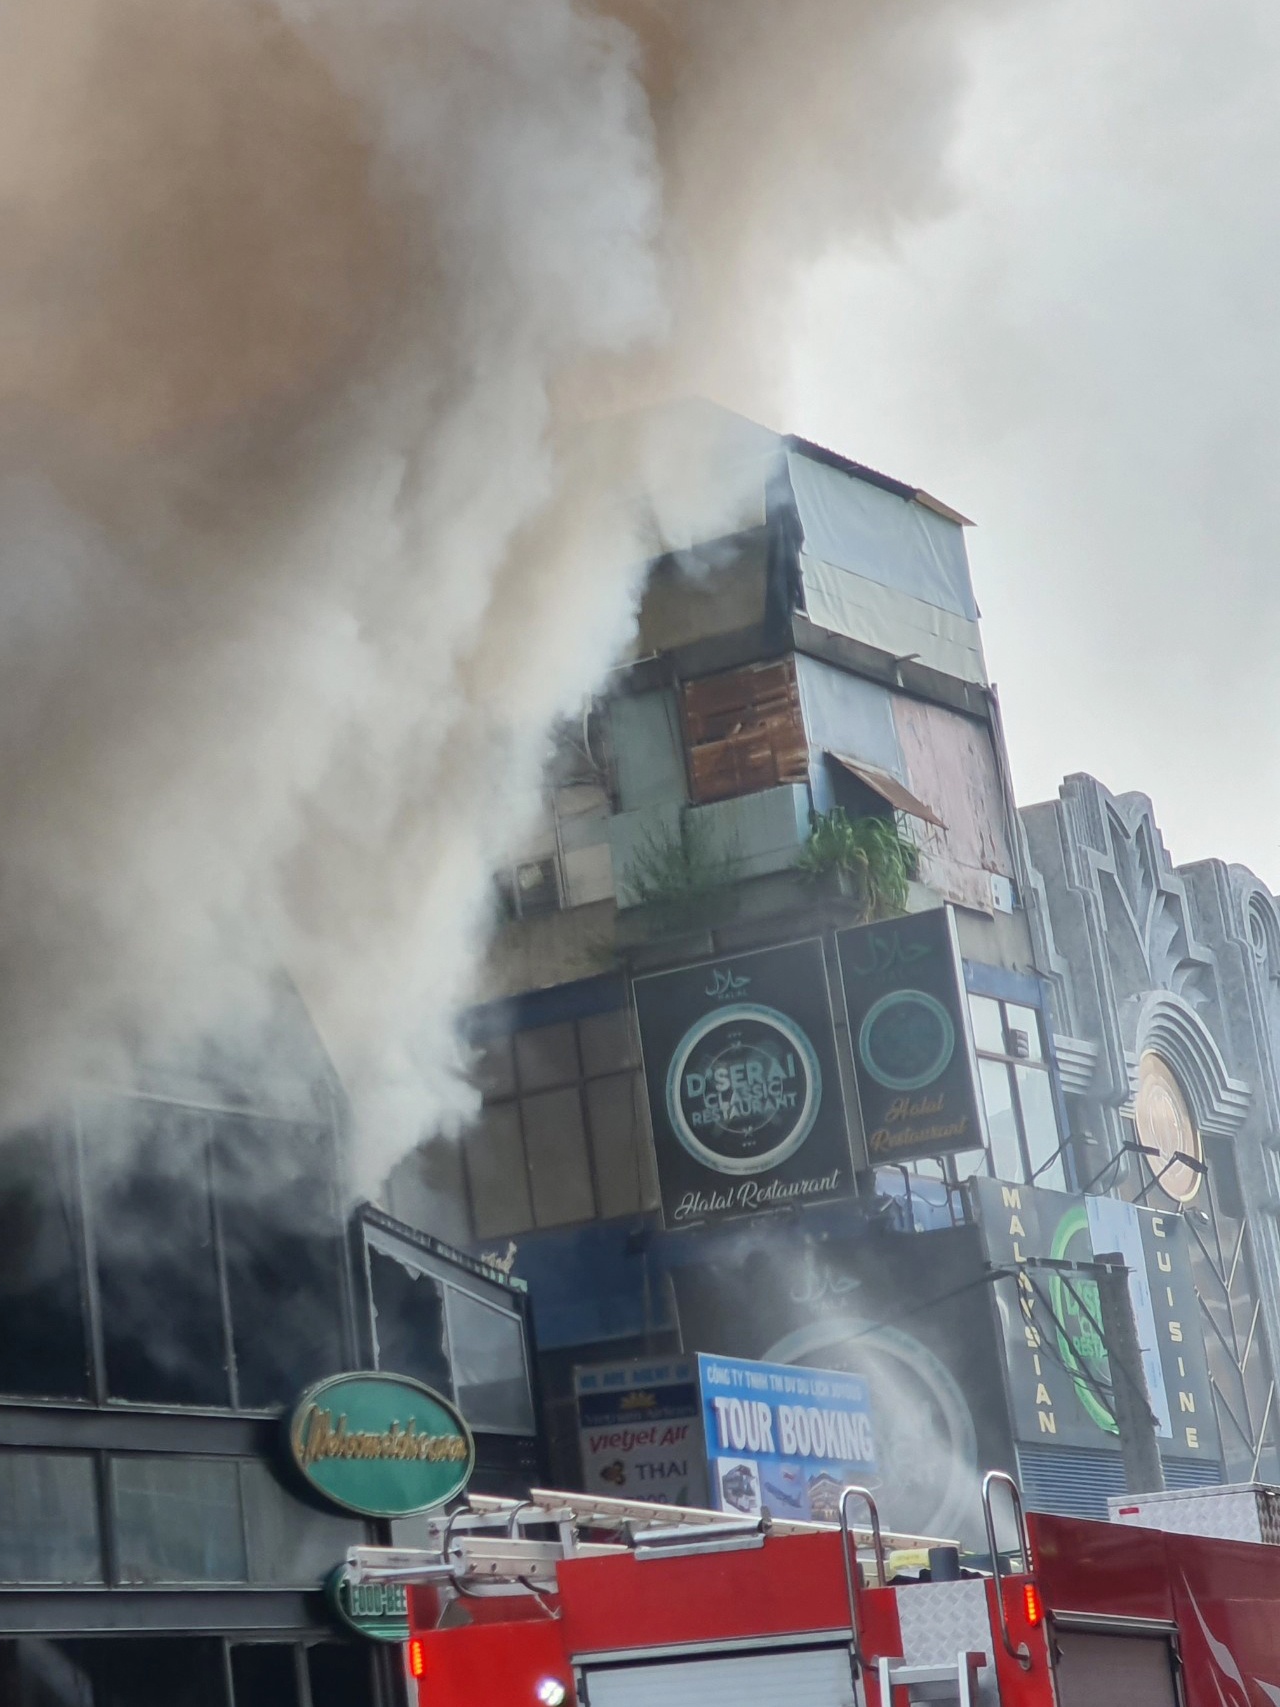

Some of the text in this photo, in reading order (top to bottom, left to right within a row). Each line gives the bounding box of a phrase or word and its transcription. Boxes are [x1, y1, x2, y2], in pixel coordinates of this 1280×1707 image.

[686, 1053, 796, 1098] D'SERAI
[704, 1077, 783, 1109] CLASSIC
[692, 1092, 797, 1127] RESTAURANT
[674, 1168, 841, 1220] Halal Restaurant
[1001, 1186, 1057, 1435] MALAYSIAN
[1151, 1216, 1201, 1449] CUISINE
[713, 1396, 875, 1463] TOUR BOOKING
[635, 1460, 688, 1480] THAI
